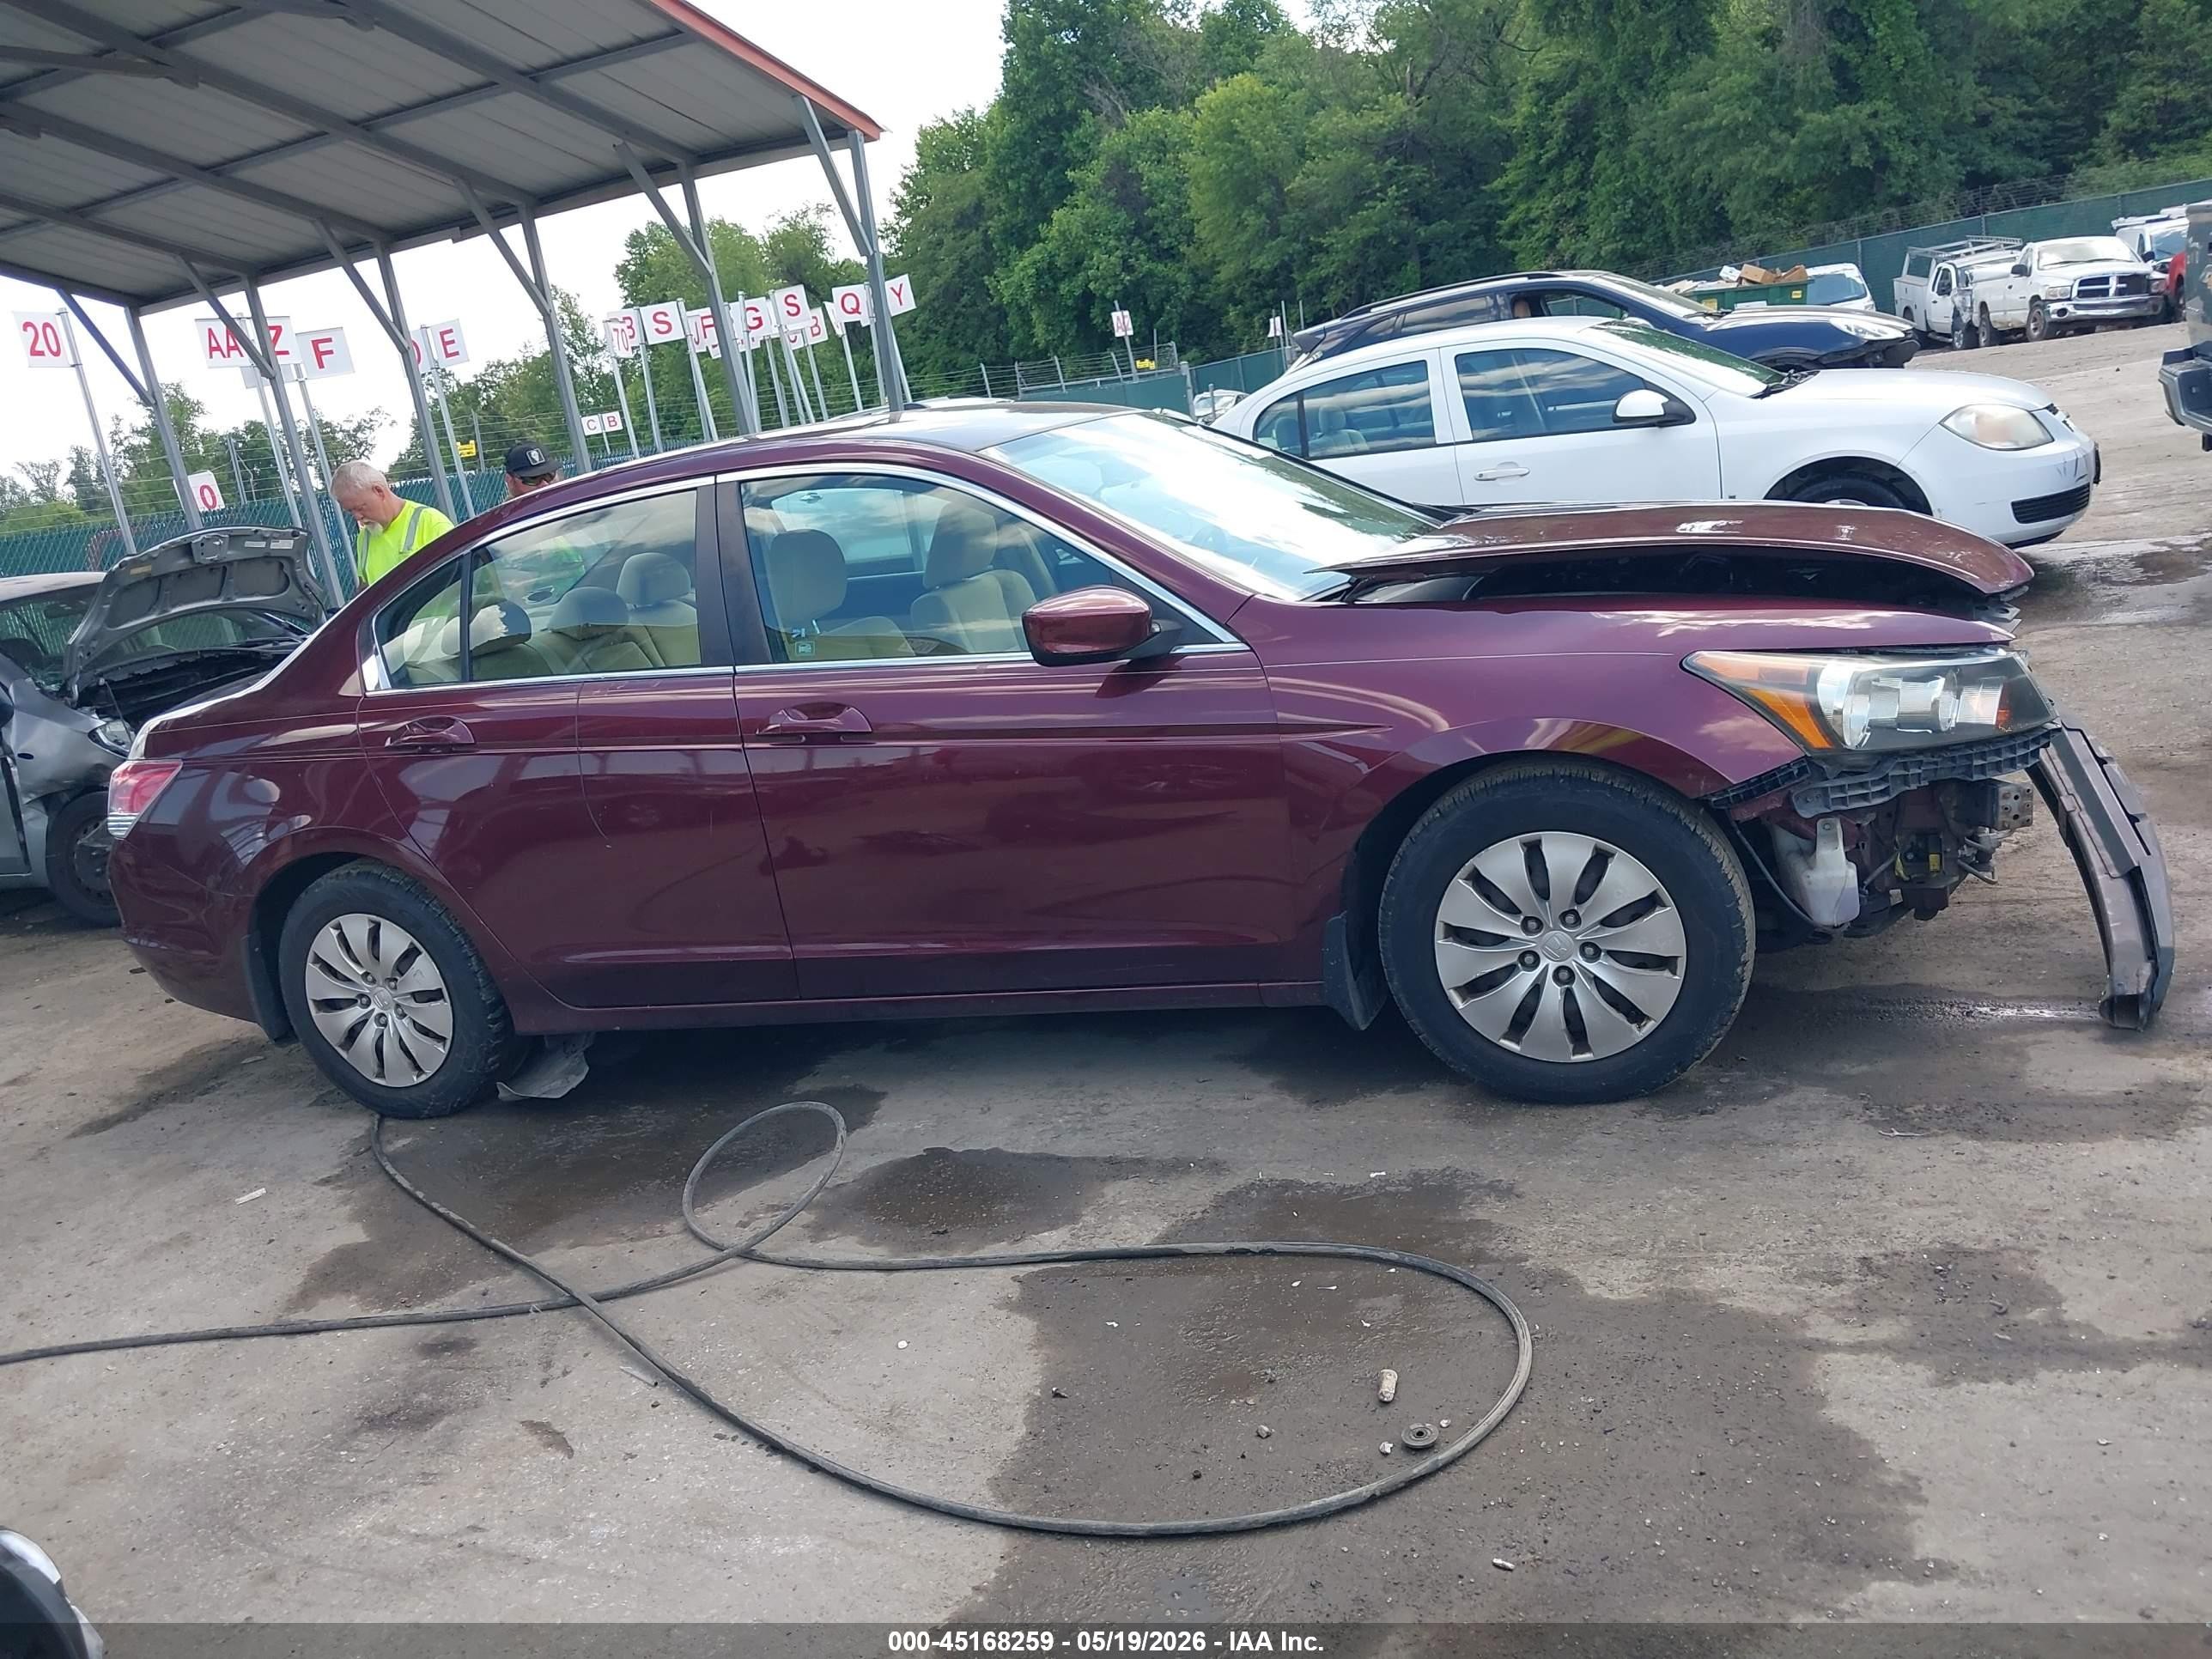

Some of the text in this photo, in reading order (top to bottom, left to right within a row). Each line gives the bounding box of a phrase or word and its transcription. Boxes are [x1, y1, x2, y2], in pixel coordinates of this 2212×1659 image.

[784, 294, 800, 317] S
[841, 293, 862, 315] Q
[890, 283, 903, 306] Y
[653, 311, 672, 335] S
[745, 307, 763, 330] G
[22, 321, 61, 357] 20
[207, 327, 244, 359] AA
[267, 325, 290, 356] Z
[440, 328, 459, 358] E
[311, 337, 334, 369] F
[586, 419, 597, 430] C
[607, 416, 617, 427] B
